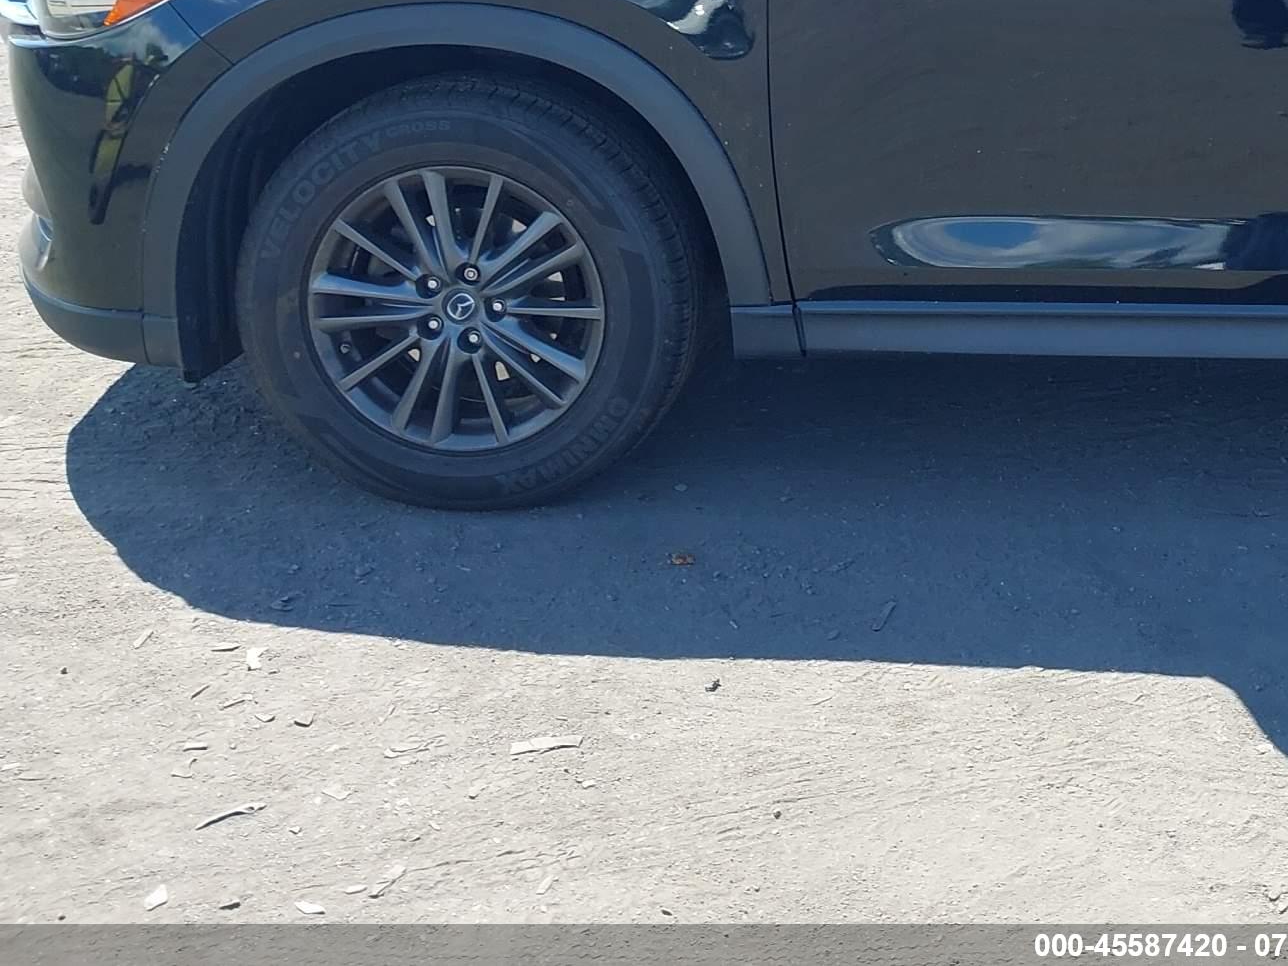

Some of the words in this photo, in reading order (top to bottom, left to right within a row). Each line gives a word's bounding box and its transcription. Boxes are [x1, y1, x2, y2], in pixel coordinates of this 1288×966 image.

[259, 129, 382, 259] VELOCITY
[385, 120, 451, 139] CROSS
[493, 396, 629, 496] OMNIMAX
